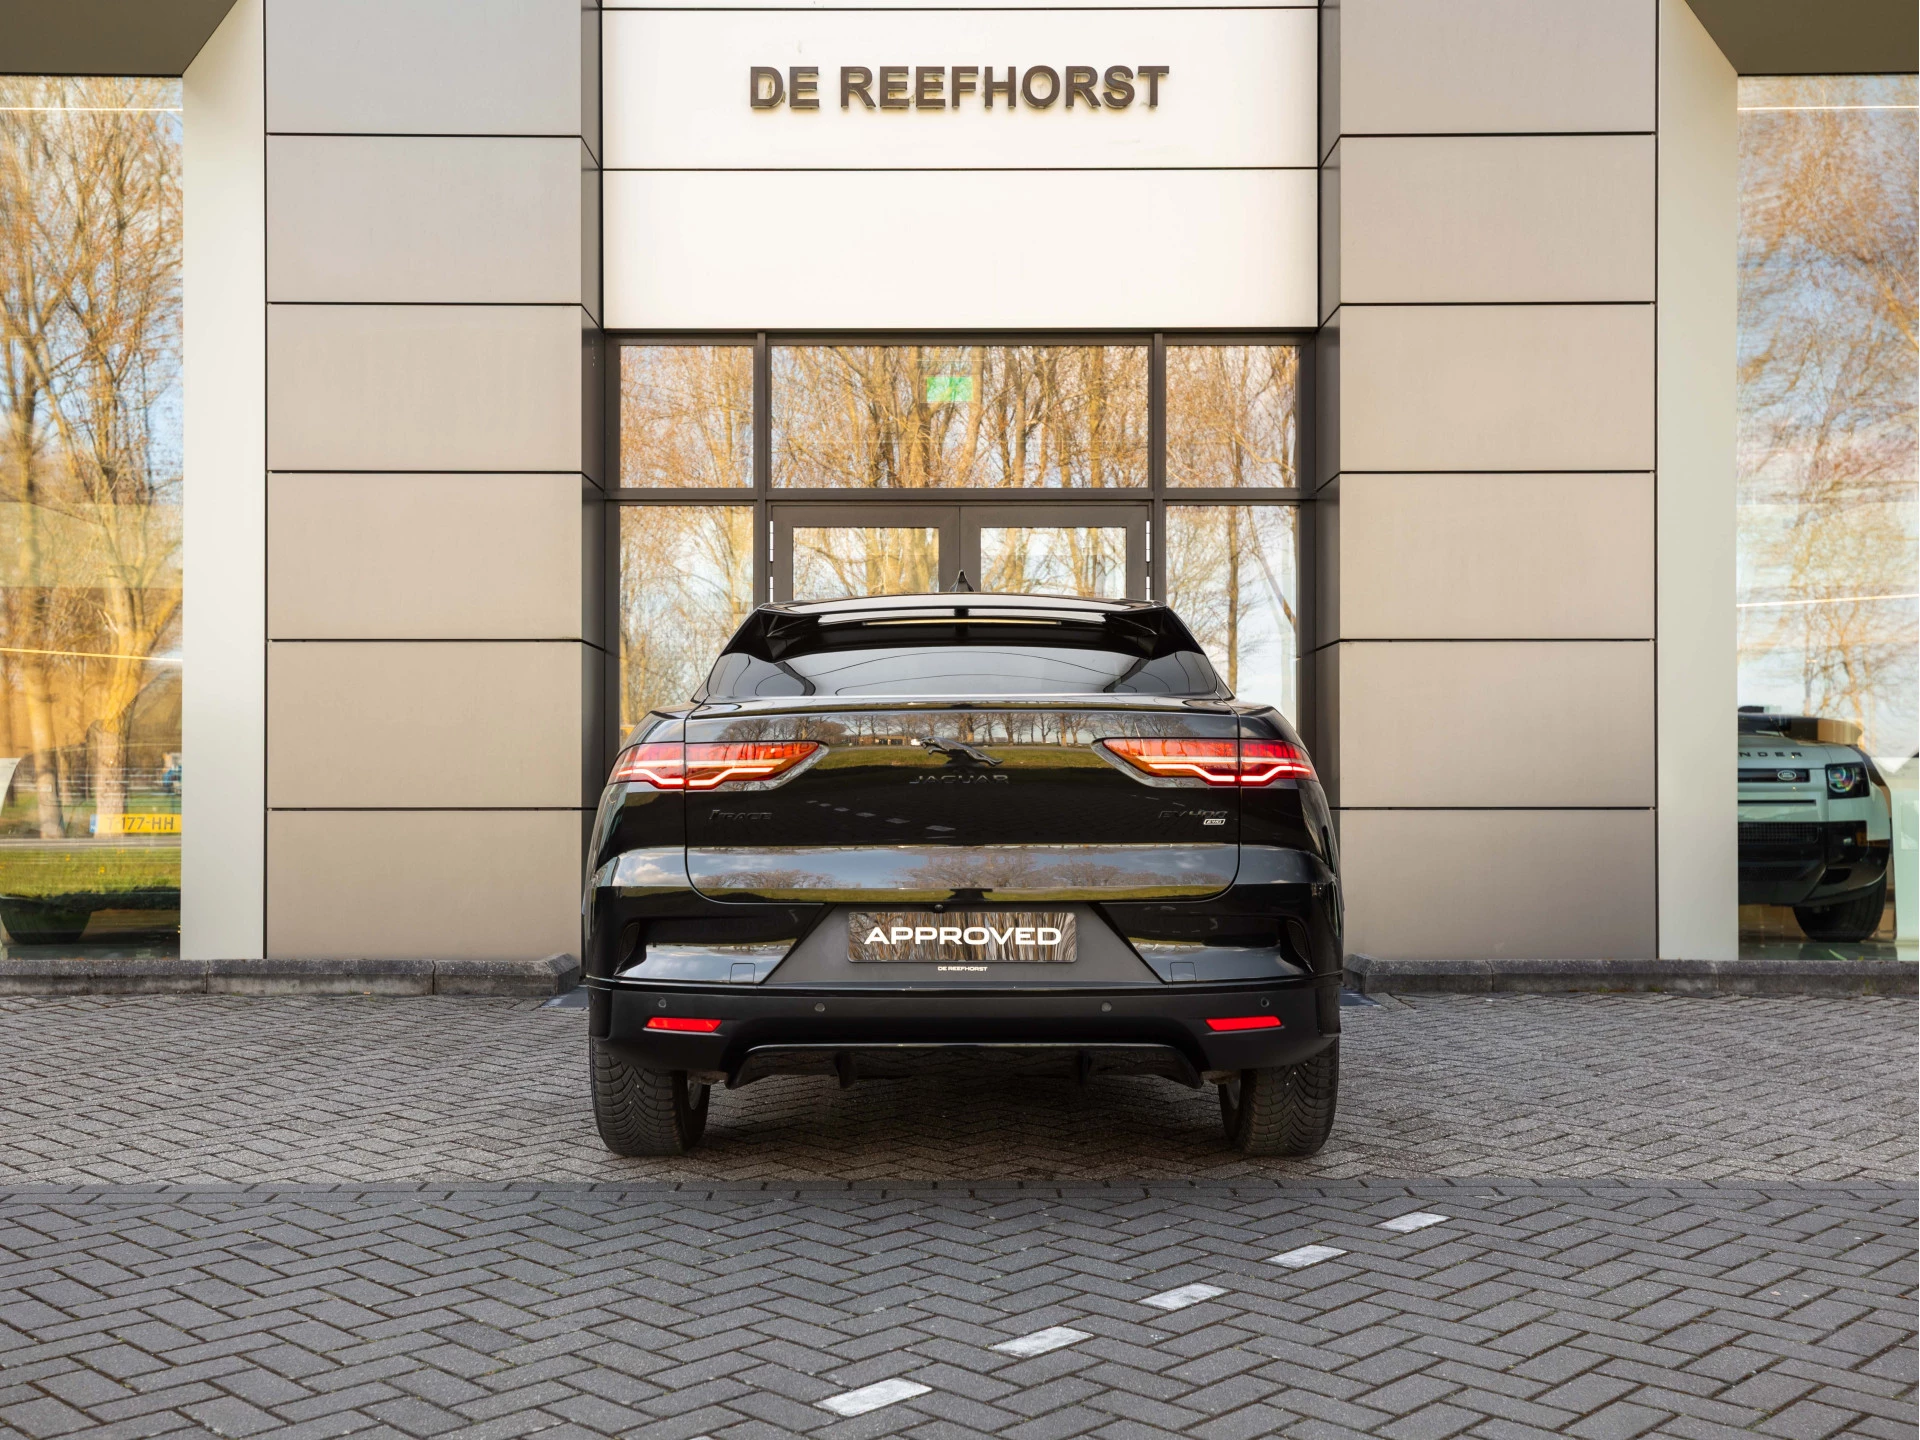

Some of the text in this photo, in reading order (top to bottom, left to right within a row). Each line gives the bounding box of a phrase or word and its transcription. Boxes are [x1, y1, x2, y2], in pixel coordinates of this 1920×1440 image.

[750, 65, 1170, 108] DE REEFHORST
[908, 774, 1010, 785] JAGUAR
[863, 926, 1062, 945] APPROVED
